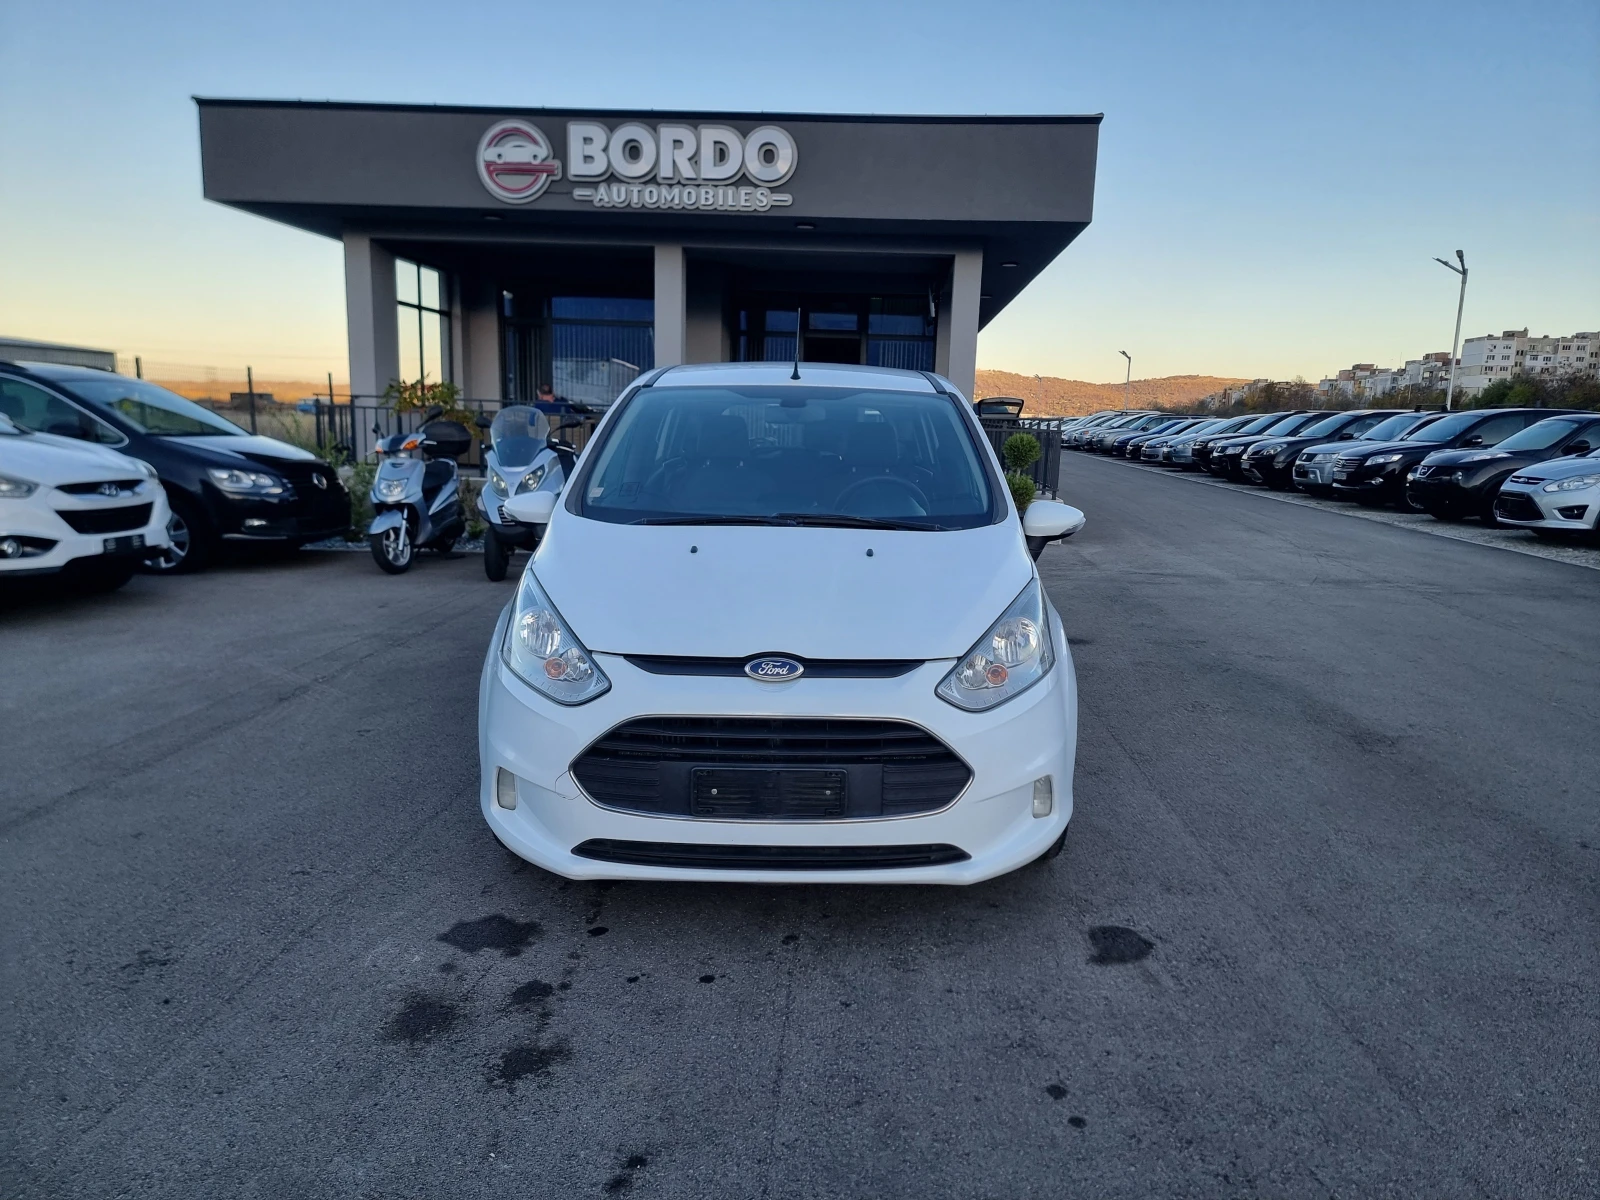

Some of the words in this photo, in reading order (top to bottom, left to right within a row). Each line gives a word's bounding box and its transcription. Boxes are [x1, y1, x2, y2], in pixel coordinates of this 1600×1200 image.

[568, 123, 795, 183] BORDO
[595, 184, 770, 208] AUTOMOBILES
[758, 661, 789, 675] Ford
